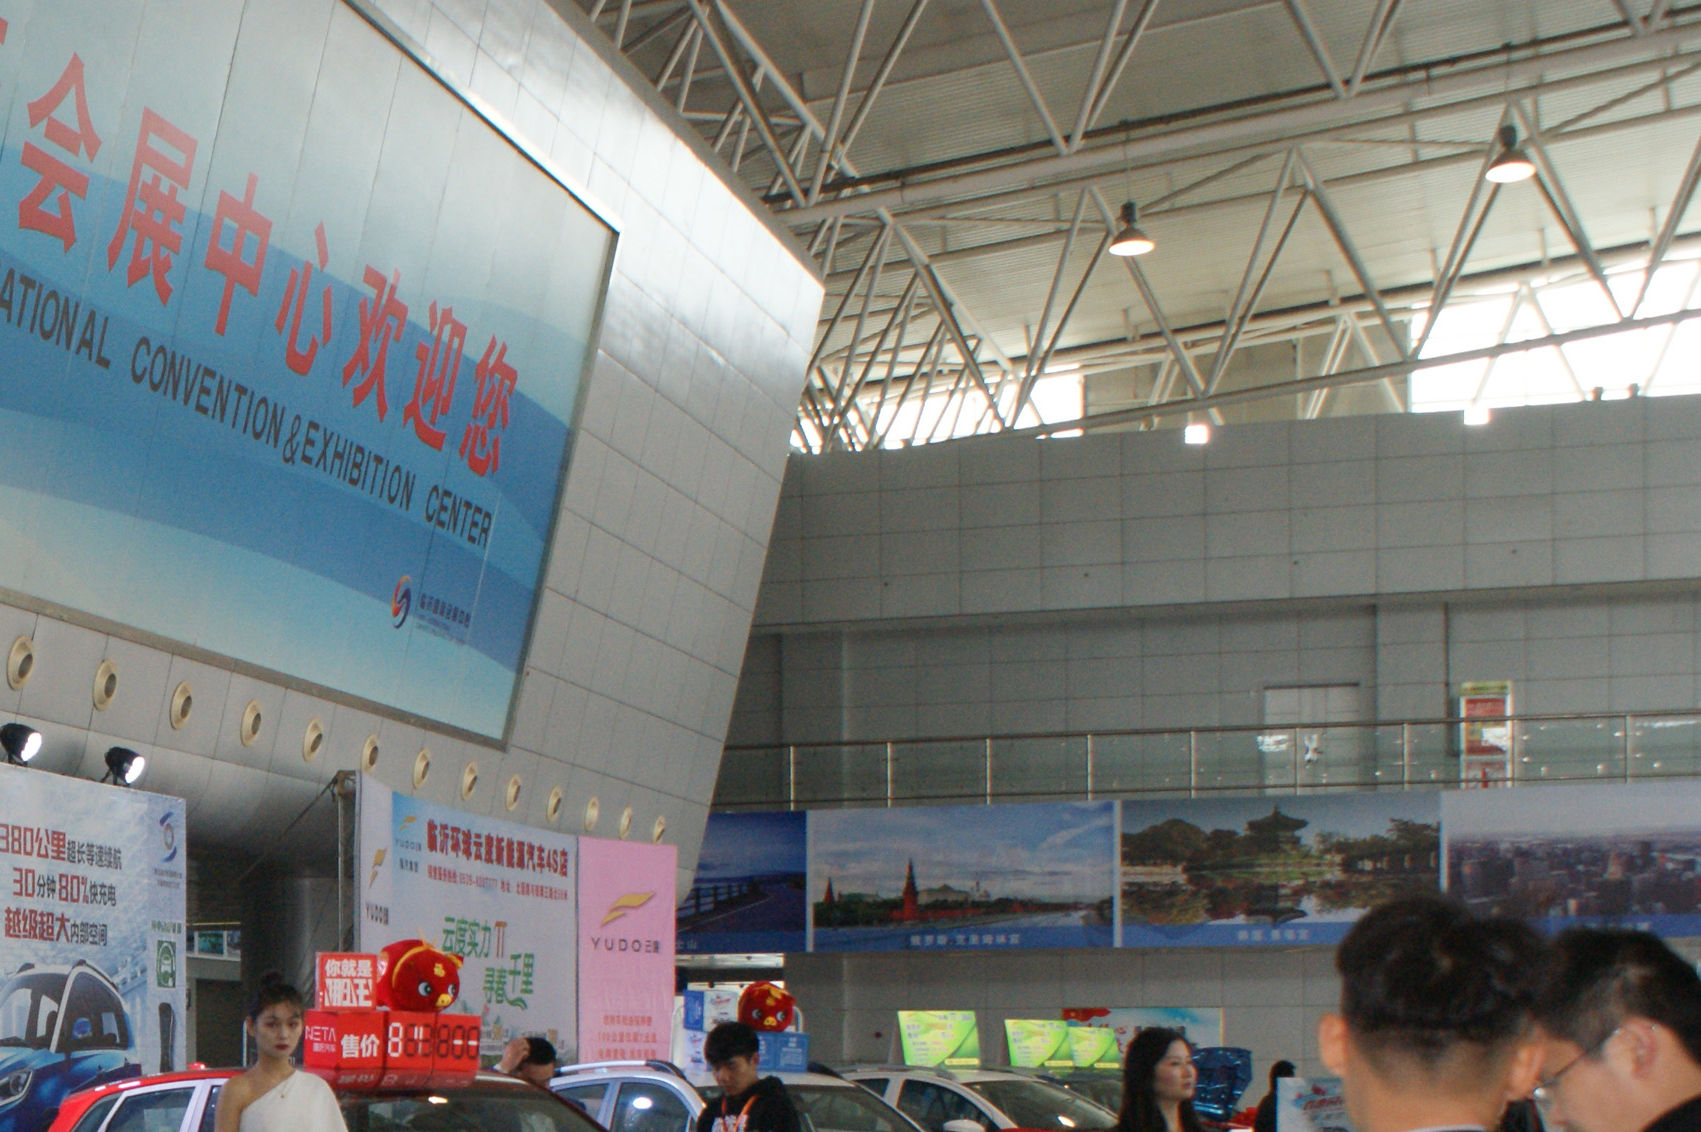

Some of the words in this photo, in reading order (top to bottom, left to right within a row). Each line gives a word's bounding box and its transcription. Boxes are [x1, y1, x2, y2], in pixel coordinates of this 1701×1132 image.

[425, 484, 493, 550] CENTER
[325, 959, 373, 978] 你就是
[305, 1025, 337, 1042] NETA
[340, 1034, 380, 1059] 售价
